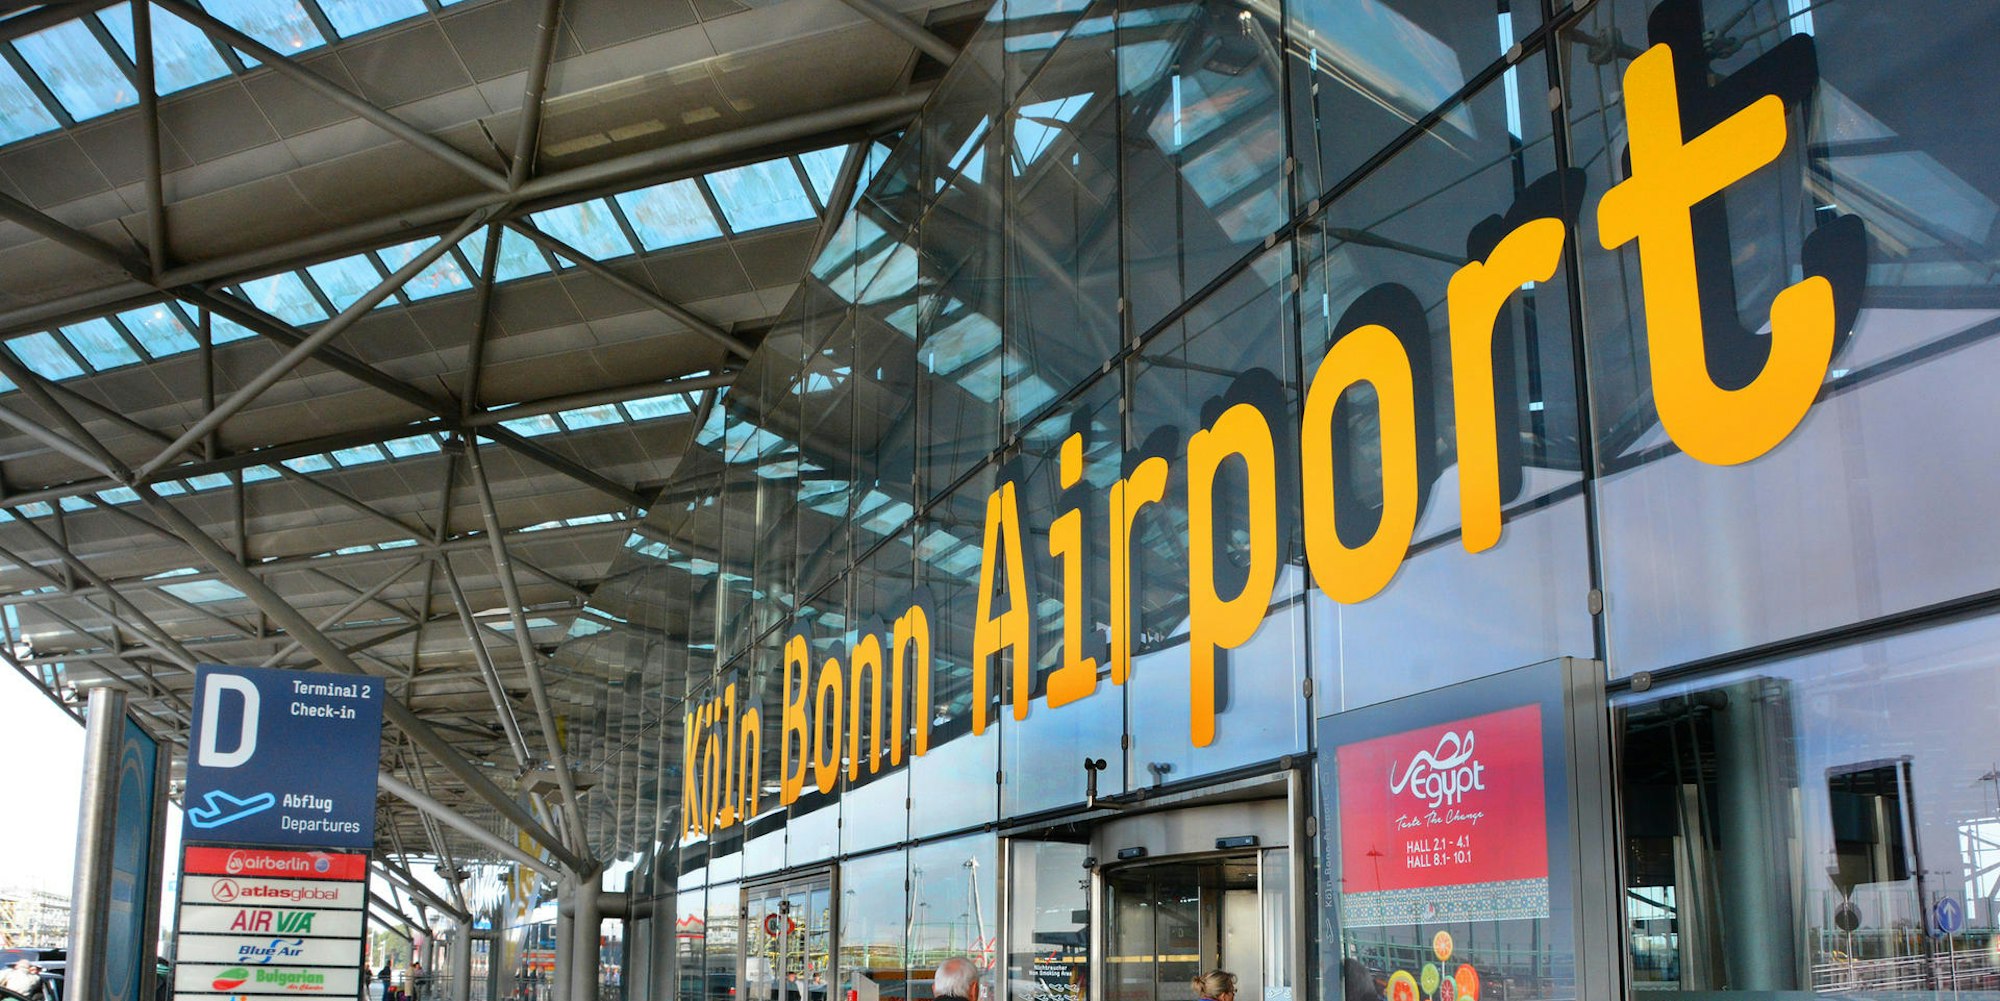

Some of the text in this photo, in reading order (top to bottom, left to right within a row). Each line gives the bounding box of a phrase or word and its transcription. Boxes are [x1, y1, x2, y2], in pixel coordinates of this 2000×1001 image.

[683, 43, 1835, 841] Köln Bonn Airport
[293, 680, 371, 699] Terminal 2
[290, 702, 356, 719] Check-in
[198, 673, 260, 768] D
[1411, 760, 1485, 808] Egypt
[283, 793, 333, 812] Abflug
[281, 816, 360, 833] Departures
[1395, 809, 1485, 831] Taste The Change
[1407, 841, 1430, 853] HALL
[1433, 838, 1446, 851] 2.1
[1456, 835, 1470, 848] 4.1
[245, 855, 309, 872] airberlin
[1407, 855, 1431, 868] HALL
[1453, 851, 1471, 864] 10.1
[241, 885, 338, 902] atlasglobal
[230, 910, 316, 933] AIR VIA
[238, 945, 304, 957] Blue Air
[256, 969, 324, 987] Bulgarian
